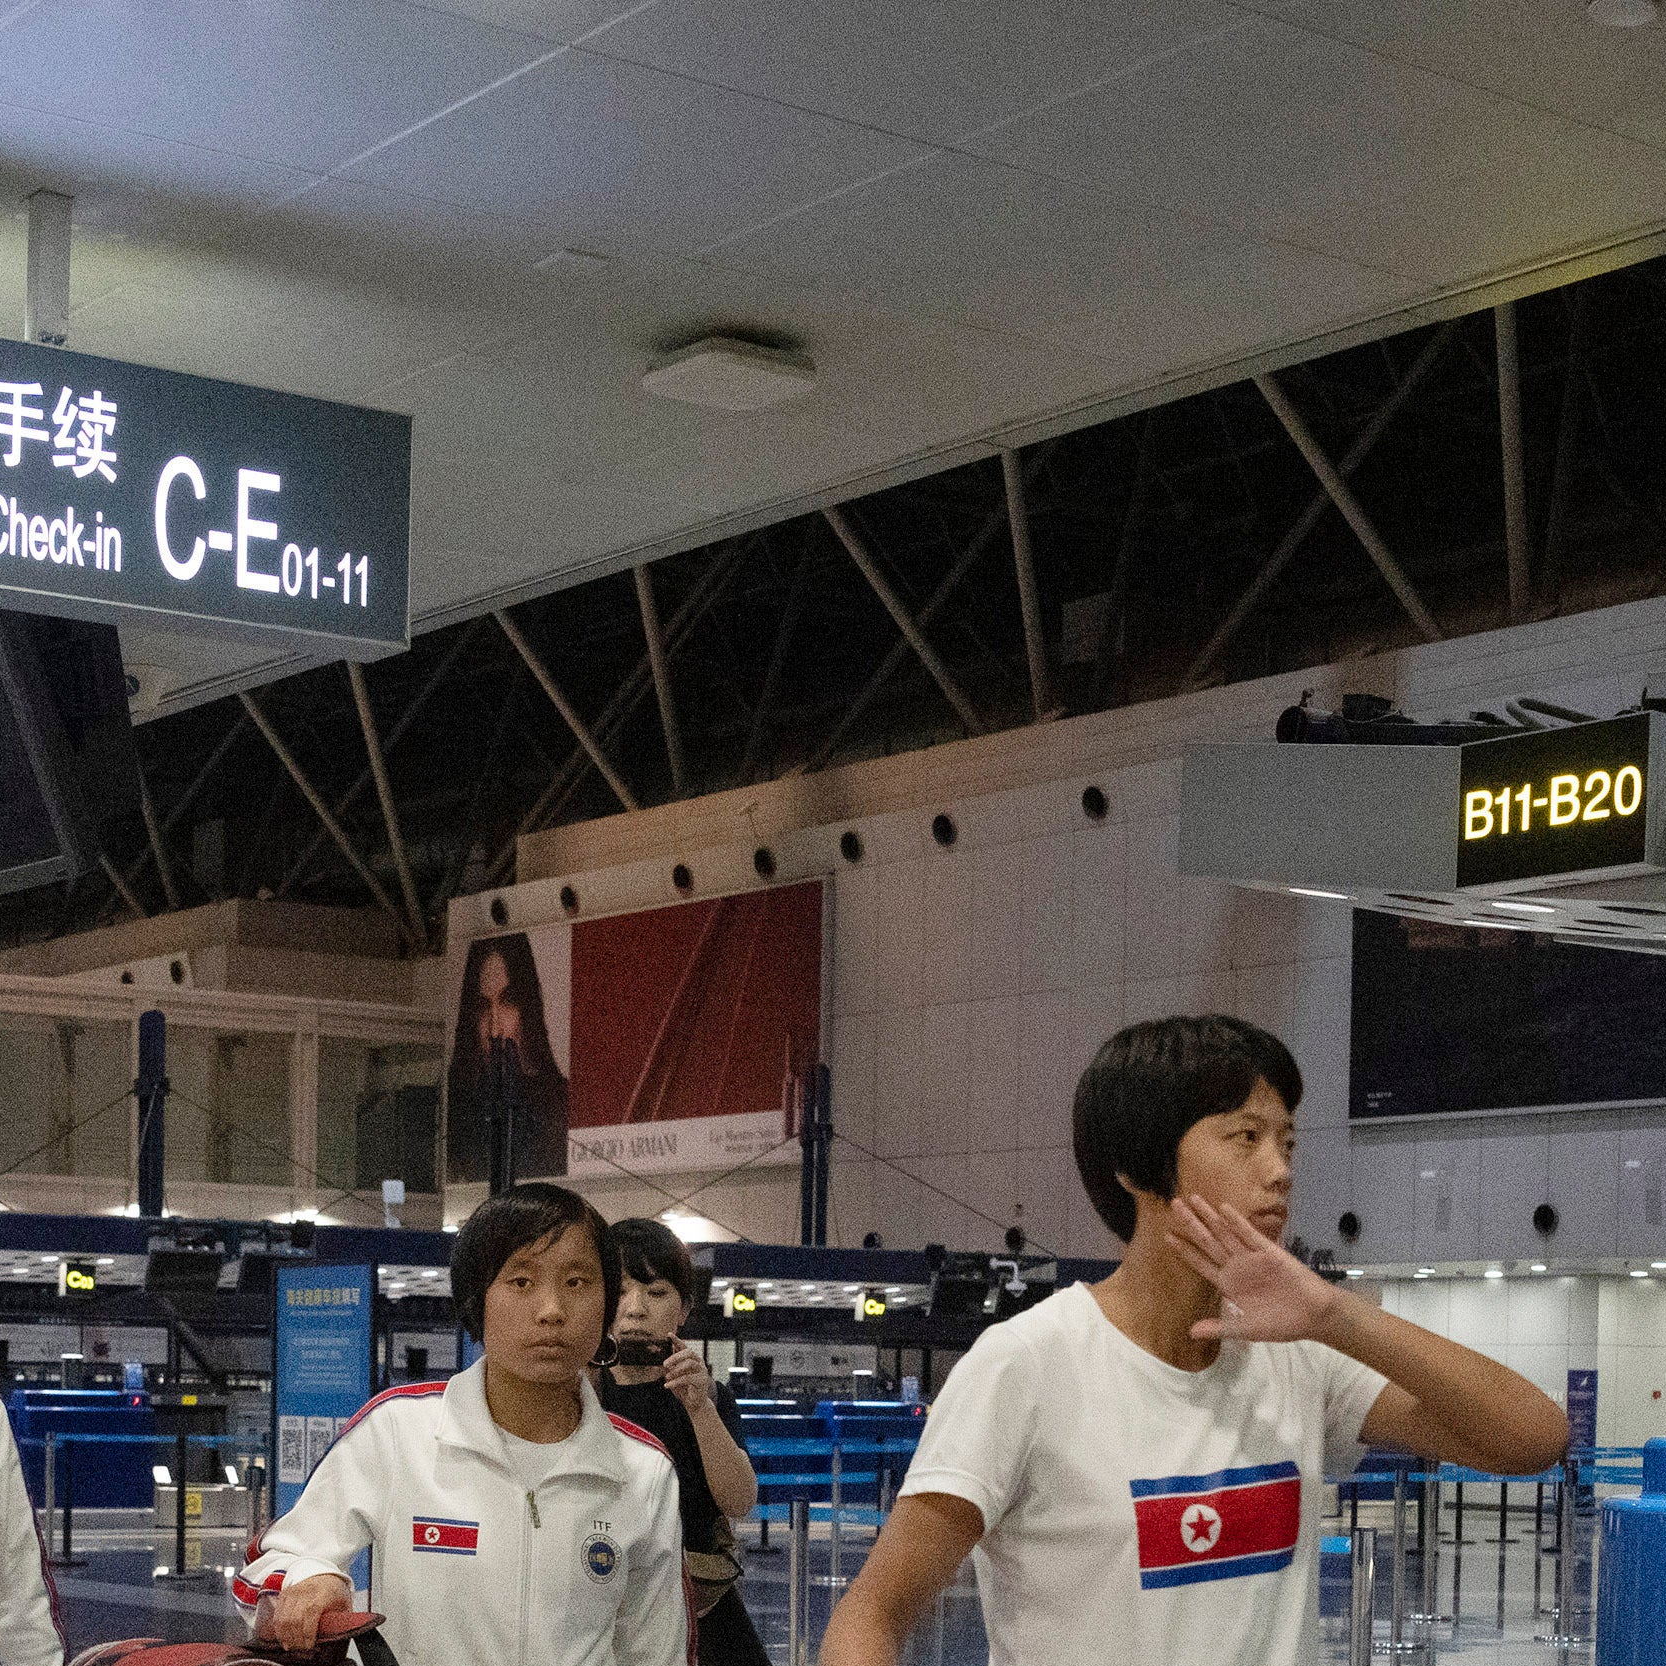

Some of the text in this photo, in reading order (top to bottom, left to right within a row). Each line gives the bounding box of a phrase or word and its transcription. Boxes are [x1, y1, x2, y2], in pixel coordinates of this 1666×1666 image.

[1463, 764, 1643, 841] B11-B20
[63, 1270, 94, 1290] C03
[593, 1520, 612, 1531] ITF
